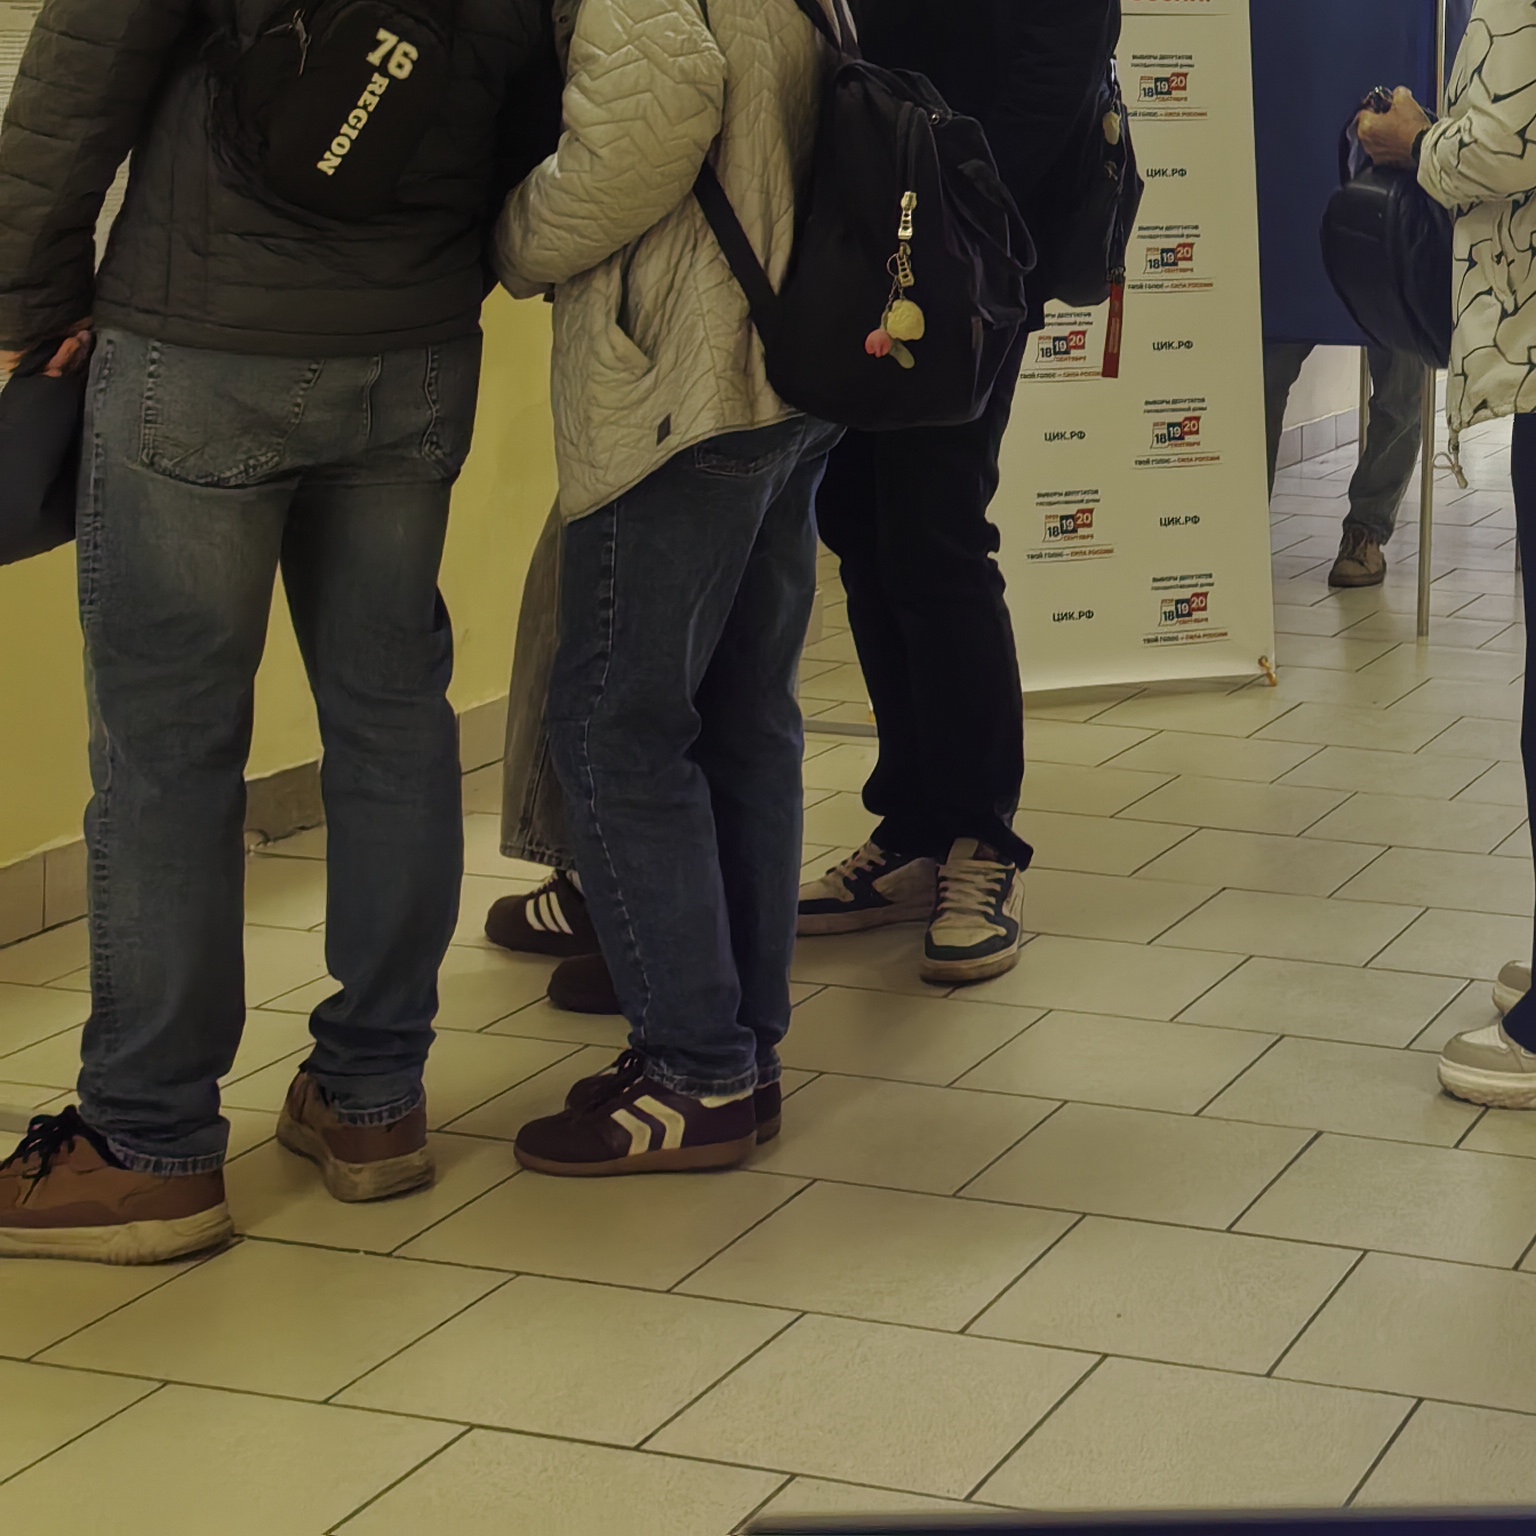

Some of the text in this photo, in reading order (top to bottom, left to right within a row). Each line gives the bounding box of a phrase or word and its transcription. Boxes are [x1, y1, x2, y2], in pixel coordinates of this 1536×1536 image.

[366, 28, 419, 80] 76
[1142, 76, 1186, 97] 18 19 20
[317, 72, 389, 176] REGION
[1146, 168, 1187, 179] ЦИК.РФ
[1148, 247, 1192, 269] 18 19 20
[1040, 334, 1084, 358] 18 19 20
[1152, 341, 1194, 351] ЦИК.РФ
[1044, 431, 1086, 442] ЦИК.РФ
[1154, 421, 1198, 444] 18 19 20
[1048, 513, 1091, 537] 18 19 20
[1160, 515, 1200, 527] ЦИК.РФ
[1053, 610, 1094, 622] ЦИК.РФ
[1163, 597, 1205, 621] 18 19 20
